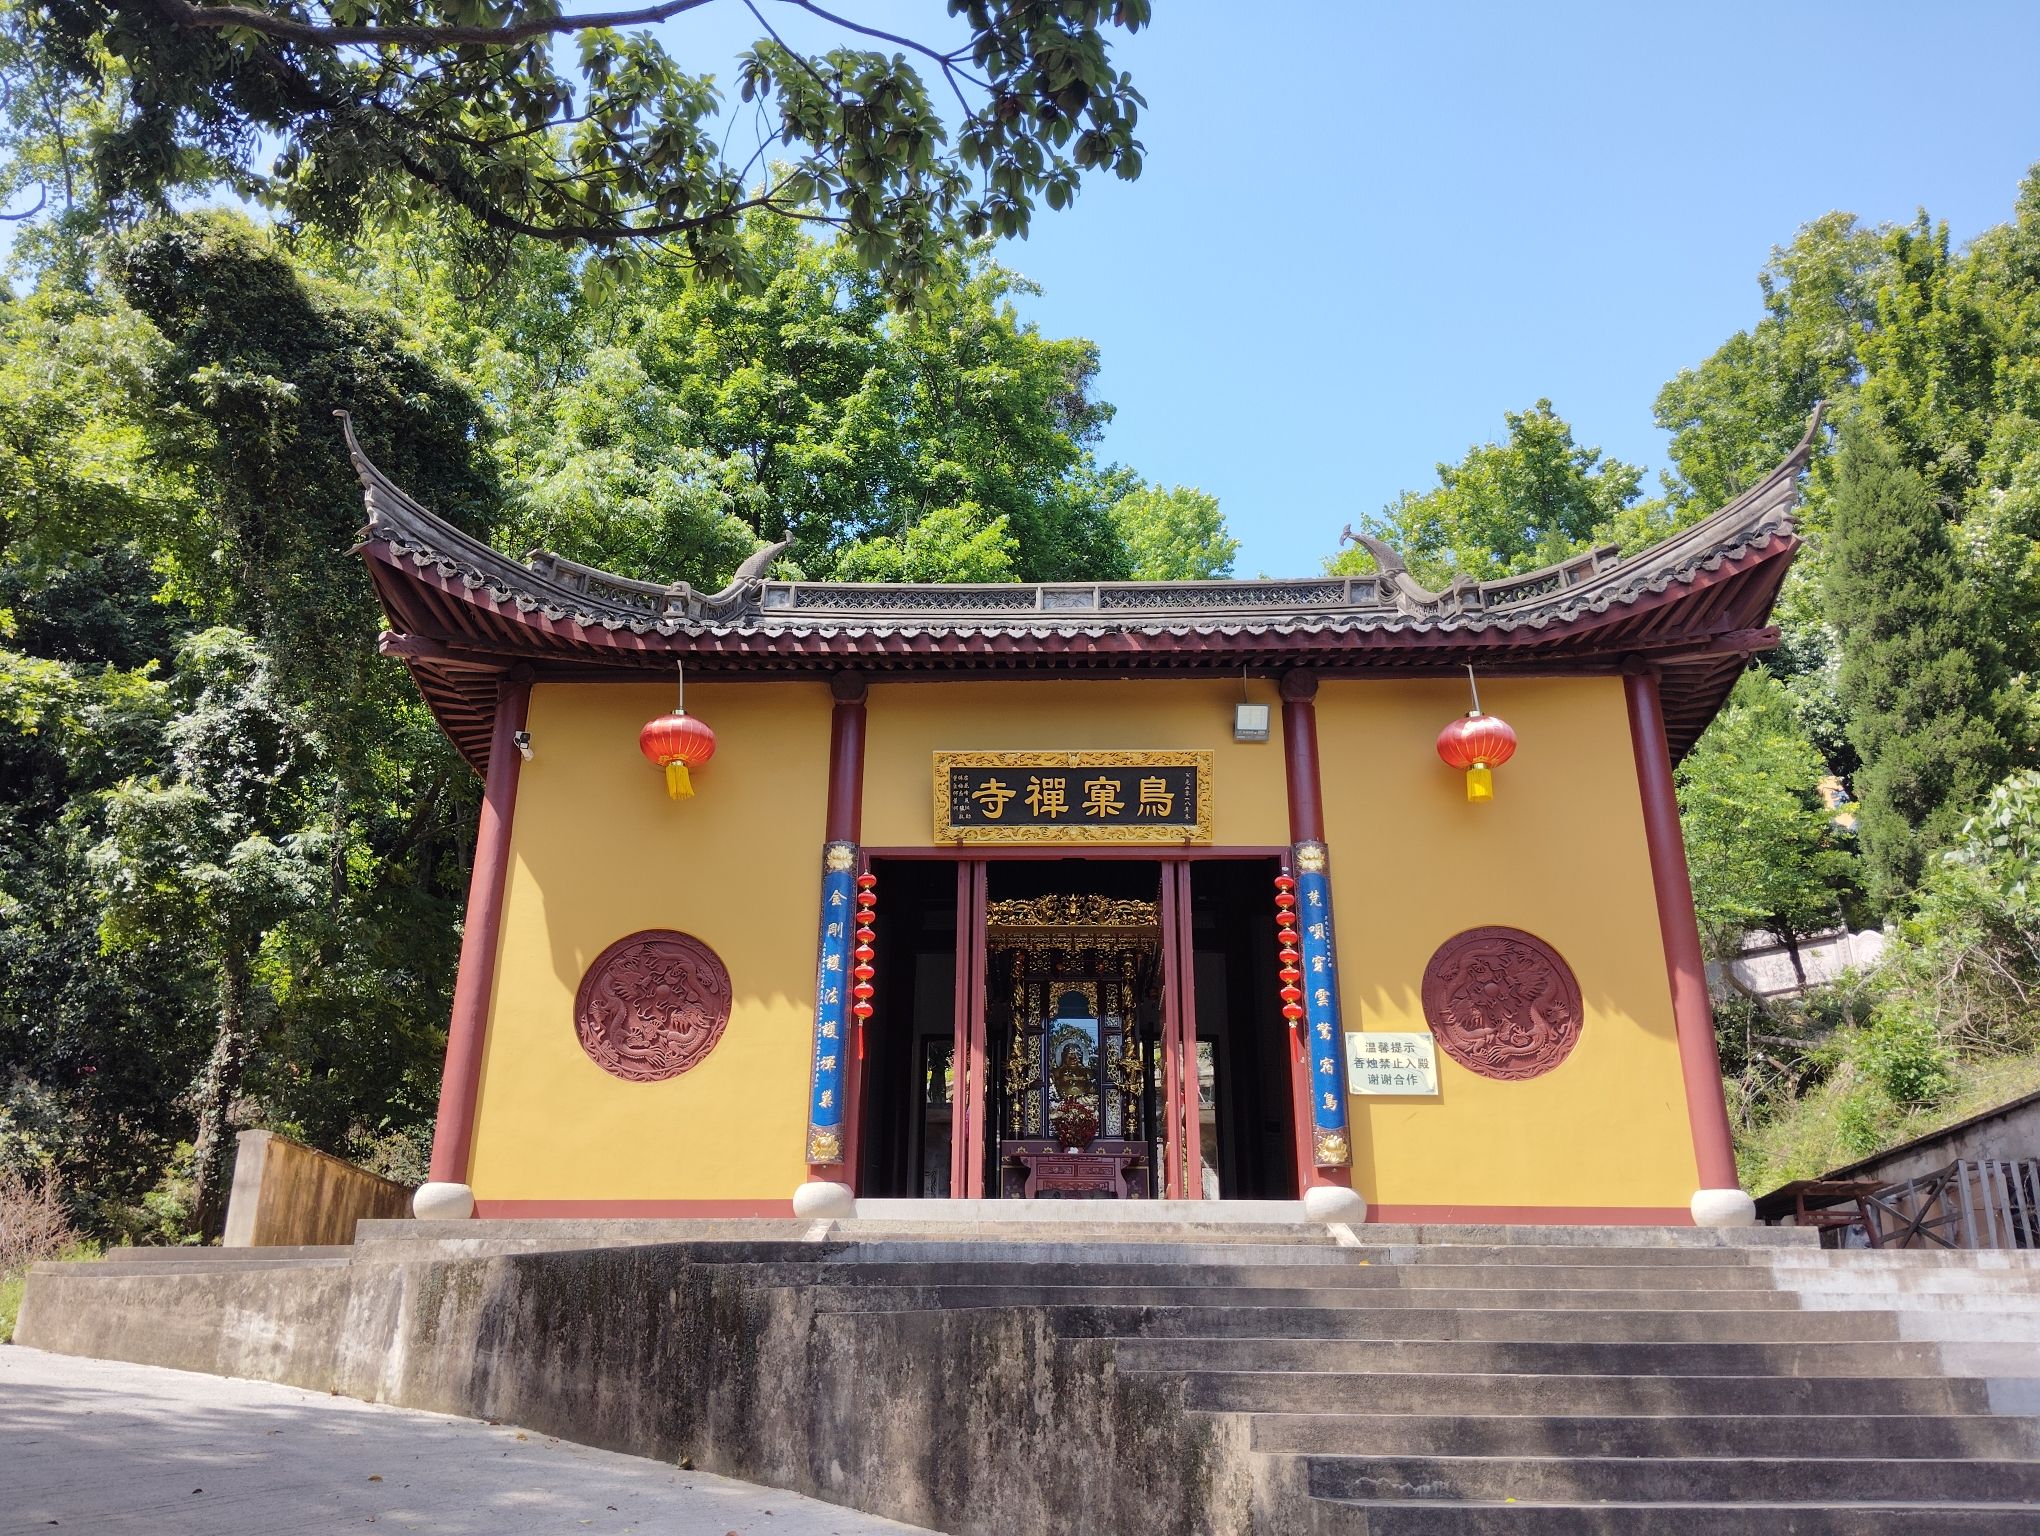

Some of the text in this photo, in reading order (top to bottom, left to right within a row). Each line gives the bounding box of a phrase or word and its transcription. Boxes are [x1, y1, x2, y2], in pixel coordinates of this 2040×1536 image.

[971, 775, 1175, 819] 鳥窠禪寺
[1365, 1042, 1415, 1053] 温馨提示
[1353, 1057, 1430, 1069] 香烛禁止入殿
[1367, 1074, 1418, 1086] 谢谢合作
